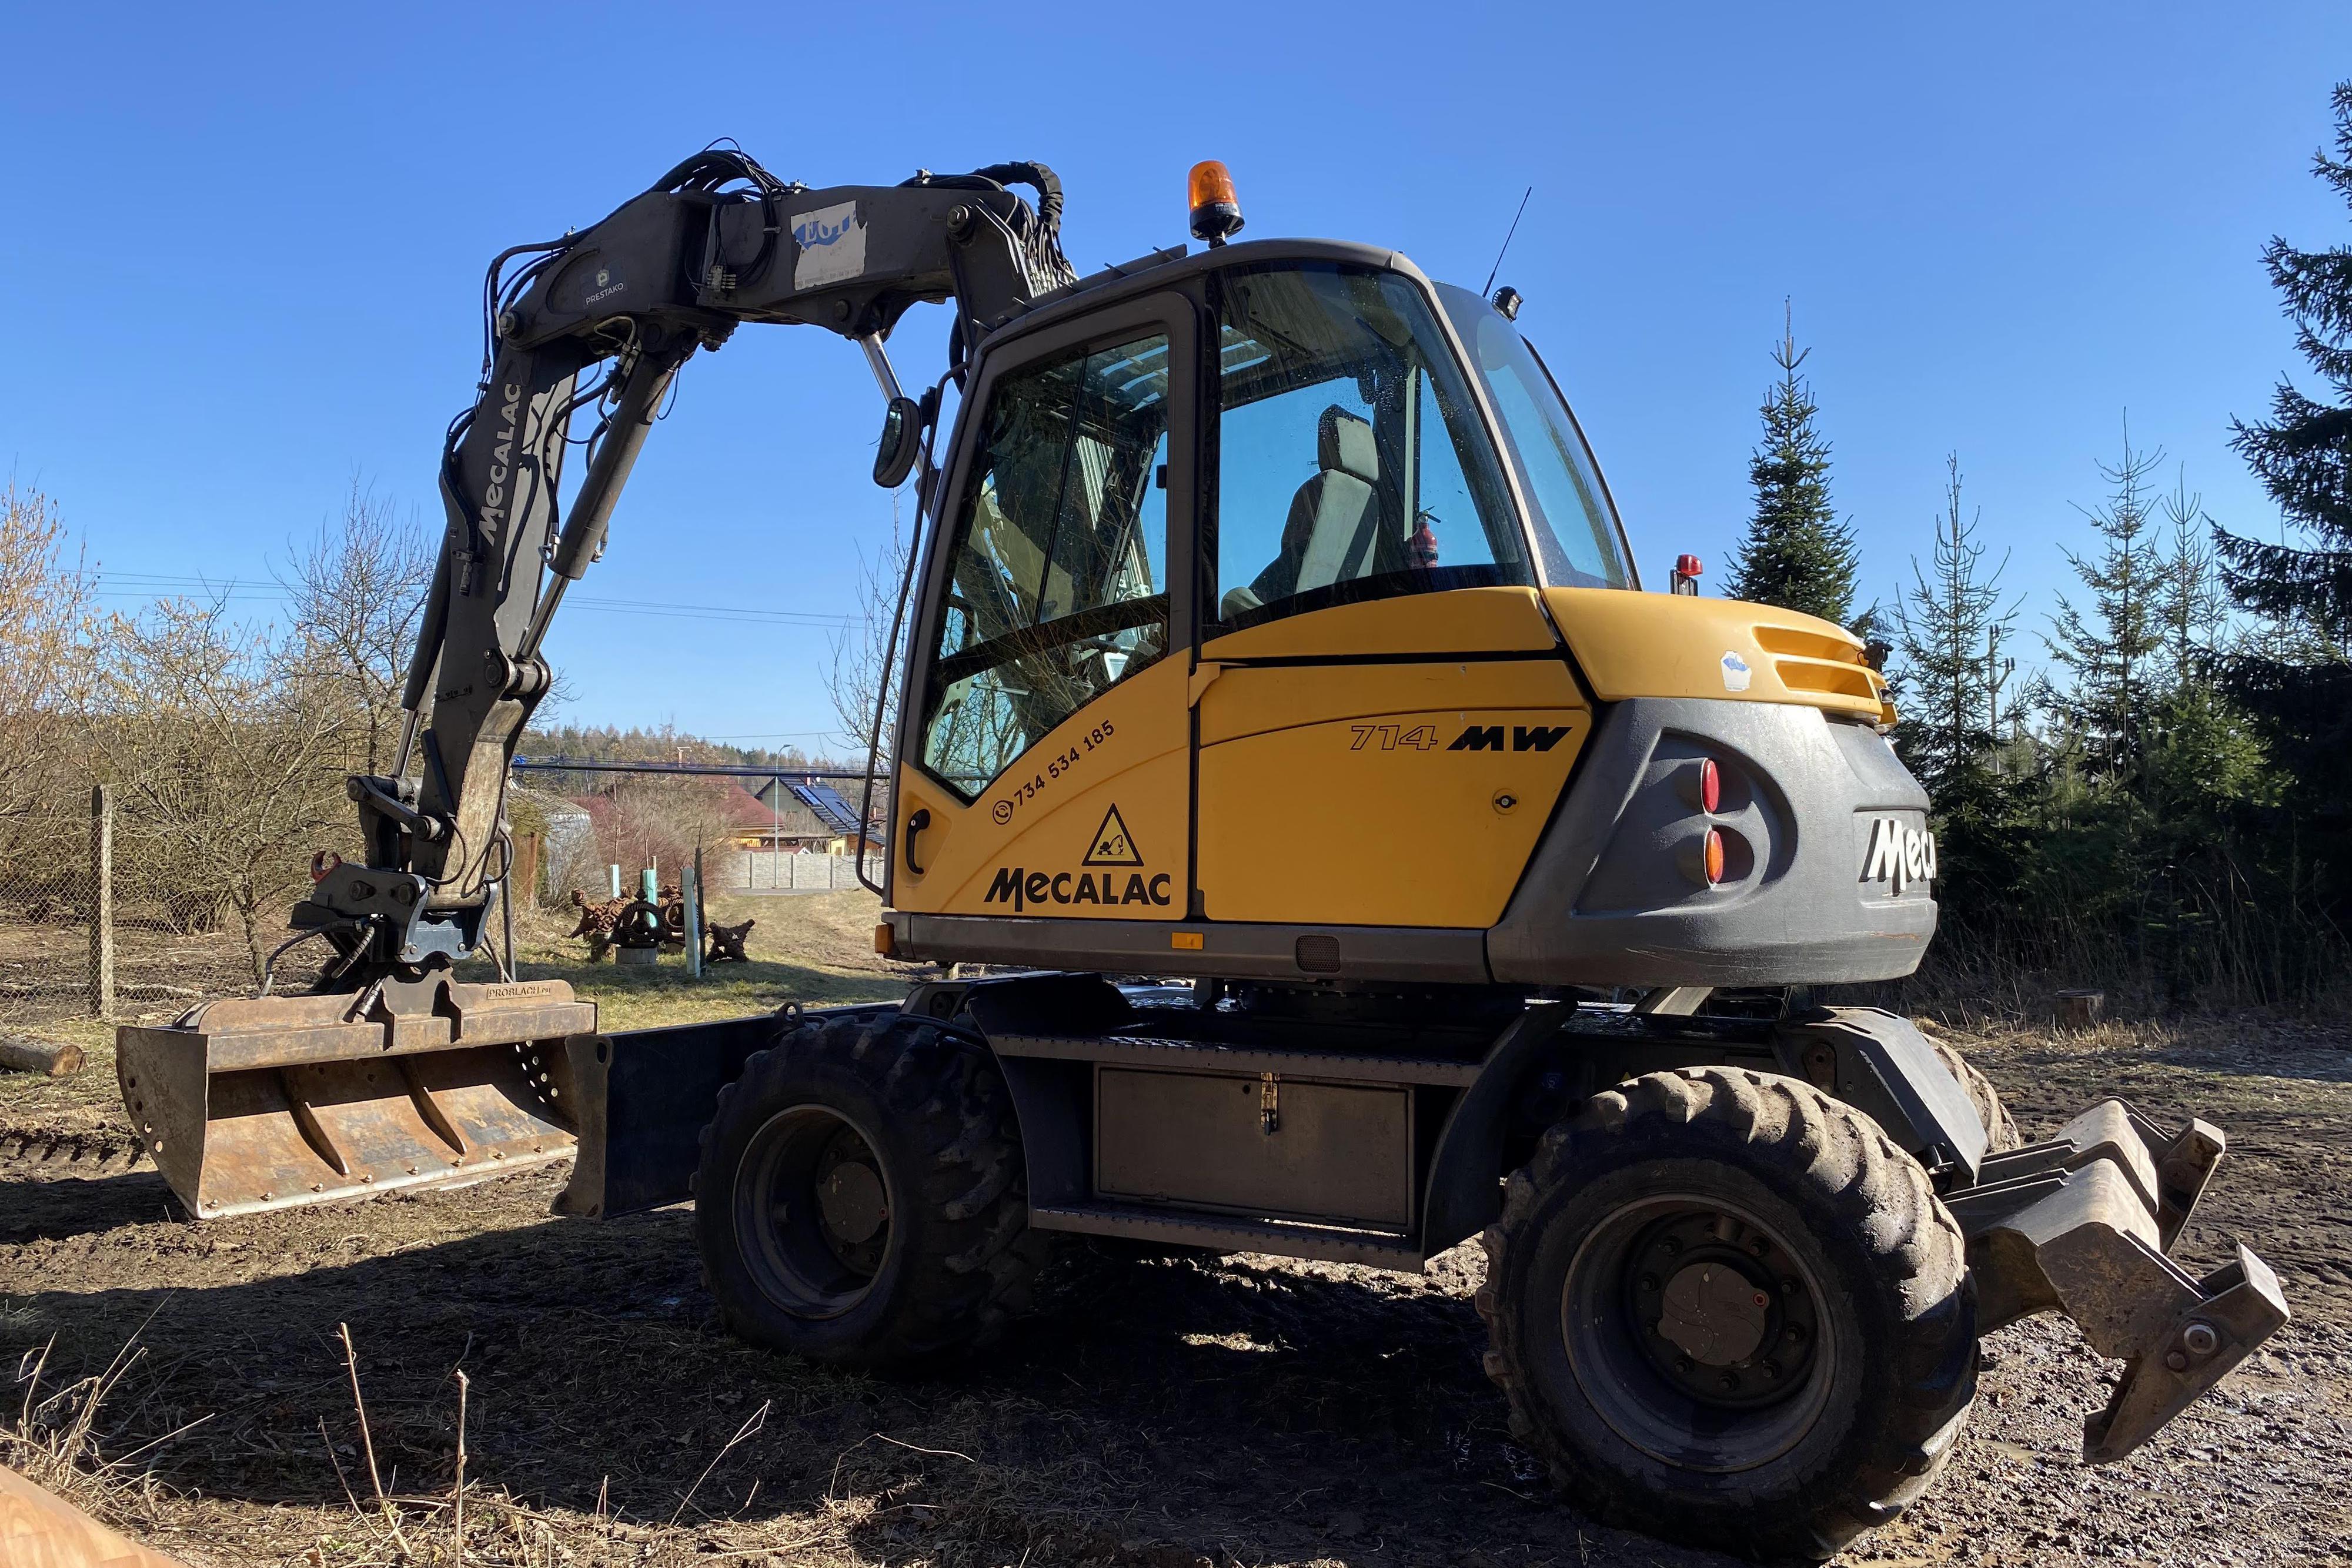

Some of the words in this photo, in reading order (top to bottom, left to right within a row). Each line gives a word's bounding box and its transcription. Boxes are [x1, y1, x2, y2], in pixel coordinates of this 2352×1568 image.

[586, 282, 624, 305] PRESTAKO
[1350, 725, 1438, 751] 714
[1446, 726, 1573, 751] MW
[1014, 774, 1045, 806] 734
[1048, 747, 1080, 778] 534
[1083, 720, 1115, 751] 185
